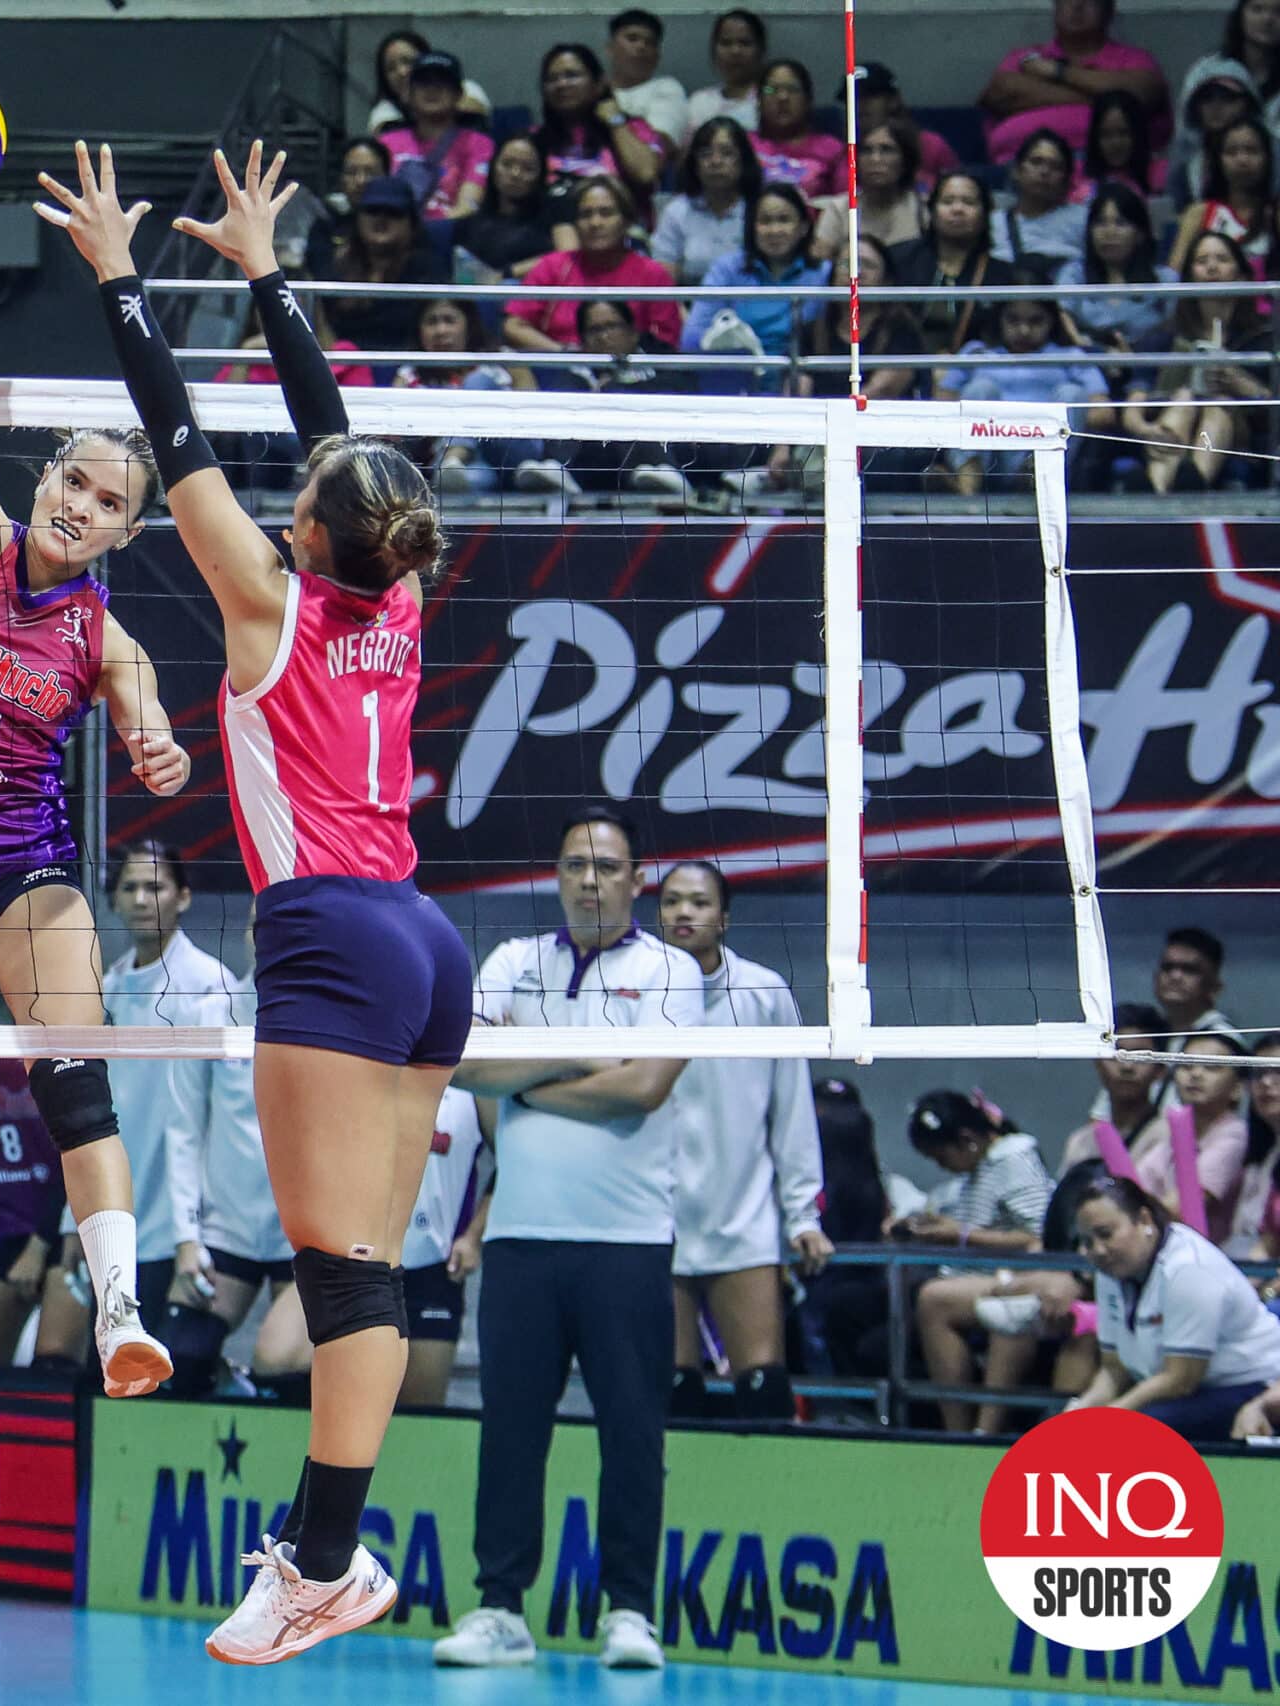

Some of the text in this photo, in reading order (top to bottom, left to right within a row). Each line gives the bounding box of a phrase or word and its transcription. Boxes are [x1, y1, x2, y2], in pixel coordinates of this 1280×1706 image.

[361, 689, 390, 812] 1
[445, 600, 1280, 830] Pizza H
[546, 1496, 901, 1666] MKASA
